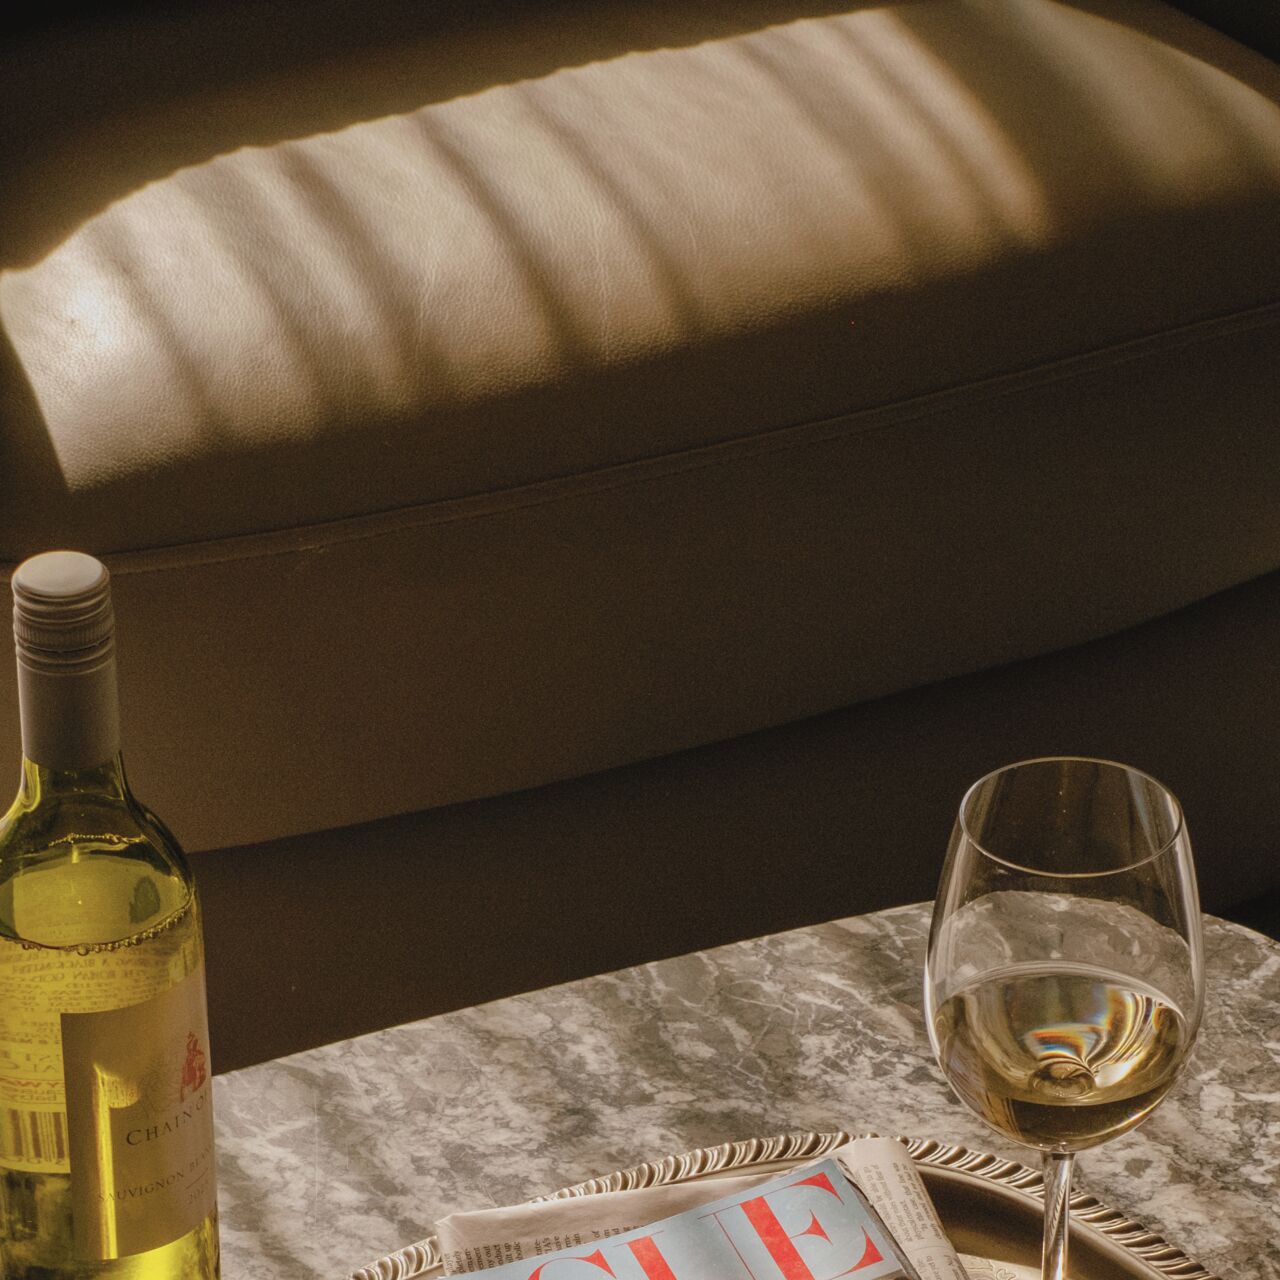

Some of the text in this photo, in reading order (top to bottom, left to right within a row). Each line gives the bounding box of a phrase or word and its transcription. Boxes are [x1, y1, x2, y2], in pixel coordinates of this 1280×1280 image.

[125, 1109, 194, 1147] CHAIN
[97, 1147, 212, 1202] SAUVIGNON BLAN
